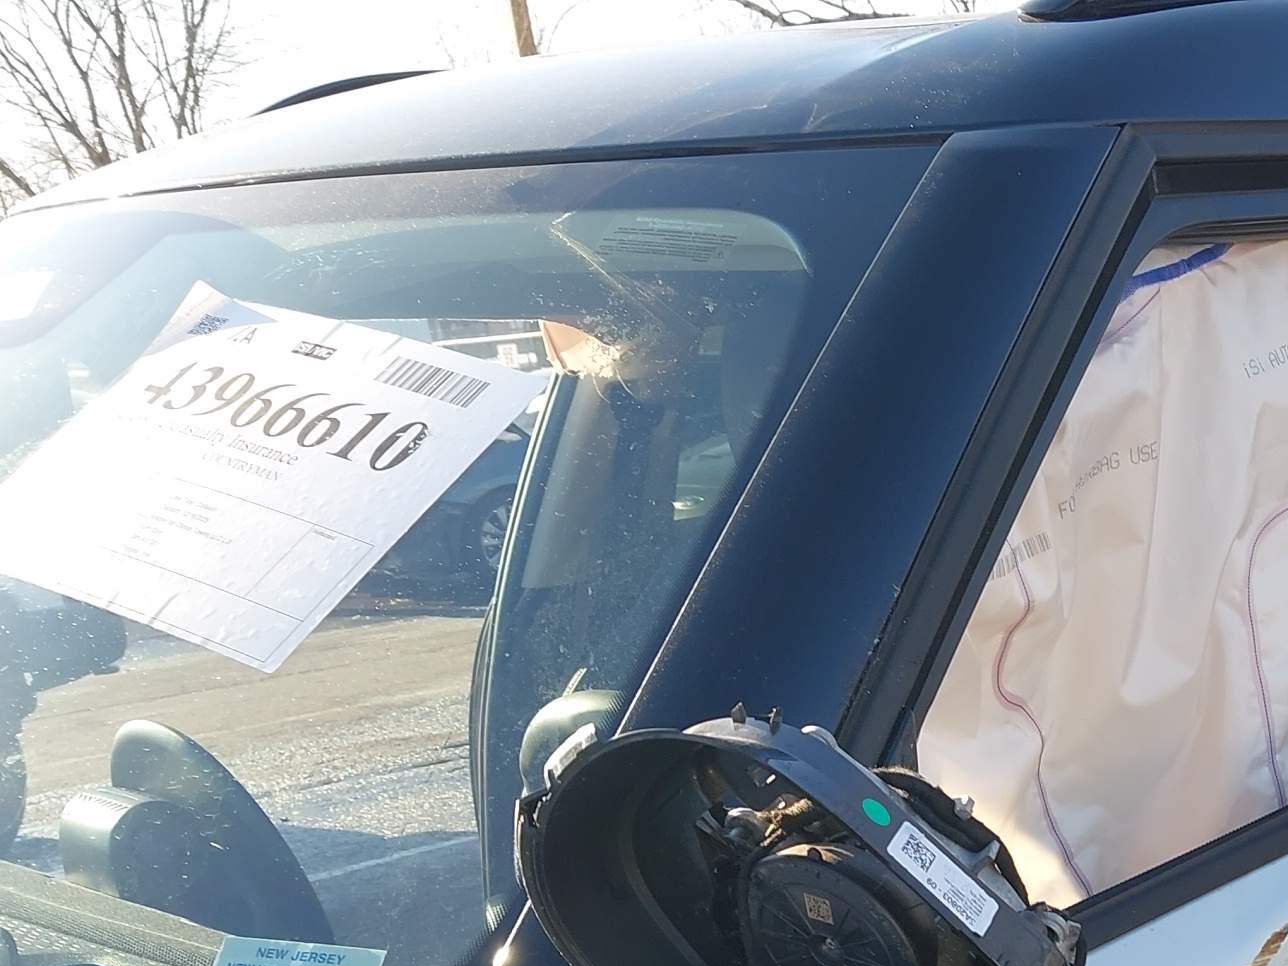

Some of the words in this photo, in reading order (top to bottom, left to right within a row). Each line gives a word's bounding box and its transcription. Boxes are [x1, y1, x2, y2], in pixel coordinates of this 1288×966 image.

[144, 361, 430, 471] 43966610
[227, 432, 299, 466] Insurance
[1129, 440, 1159, 464] USE
[256, 947, 289, 960] NEW
[291, 950, 346, 965] JERSEY
